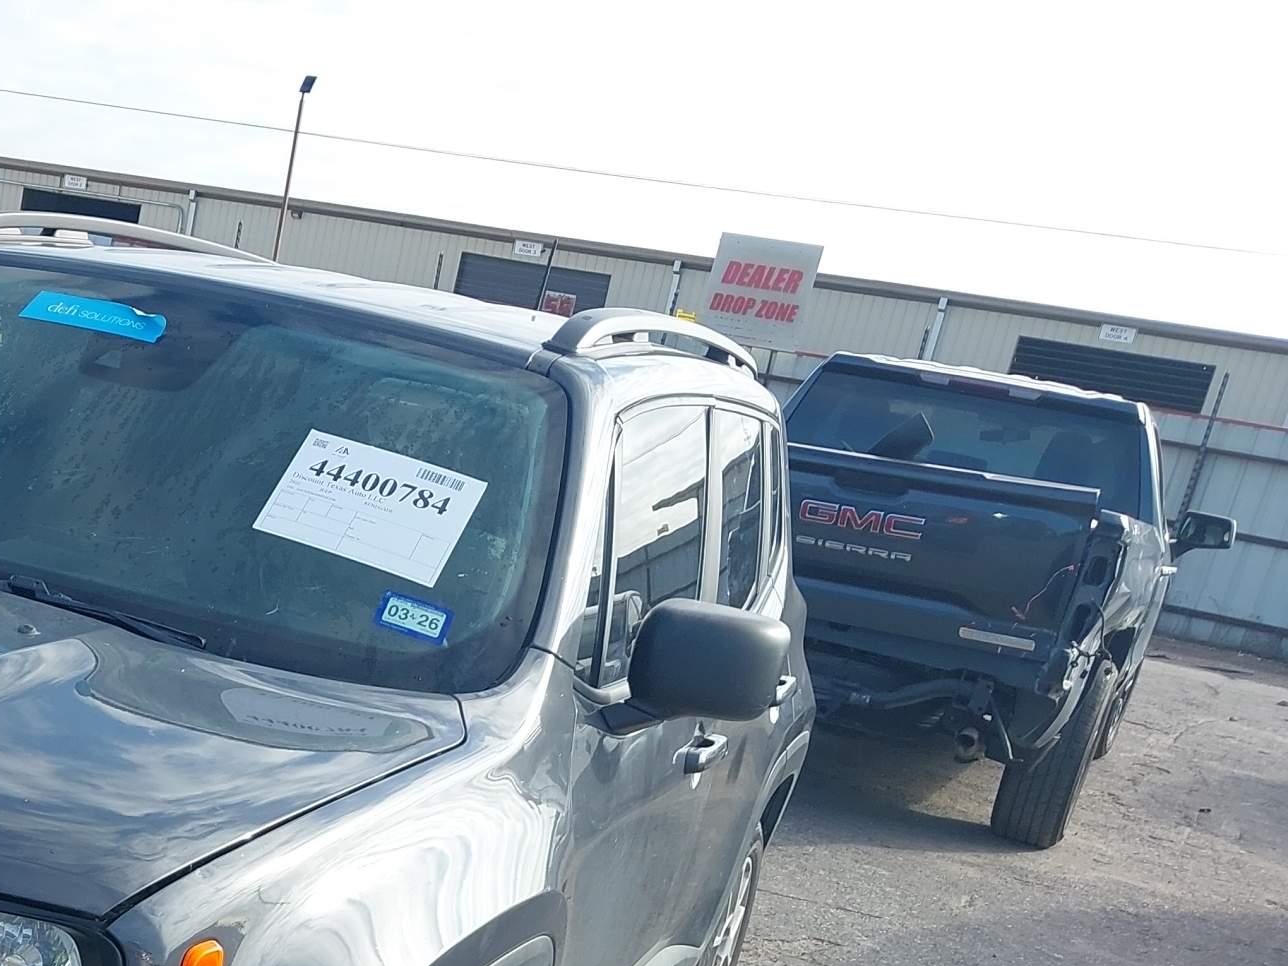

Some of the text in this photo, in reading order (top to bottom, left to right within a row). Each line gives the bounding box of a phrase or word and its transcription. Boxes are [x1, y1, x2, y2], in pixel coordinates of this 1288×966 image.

[721, 261, 803, 294] DEALER
[47, 302, 146, 330] defi SOLUTIONS
[709, 292, 799, 323] DROP ZONE
[292, 472, 325, 486] Discount
[327, 481, 347, 492] Texas
[348, 488, 367, 498] Auto
[368, 493, 385, 504] LLC
[309, 459, 451, 516] 44400784
[799, 499, 926, 540] GMC
[796, 535, 912, 562] SIERRA
[388, 605, 440, 630] 03 26
